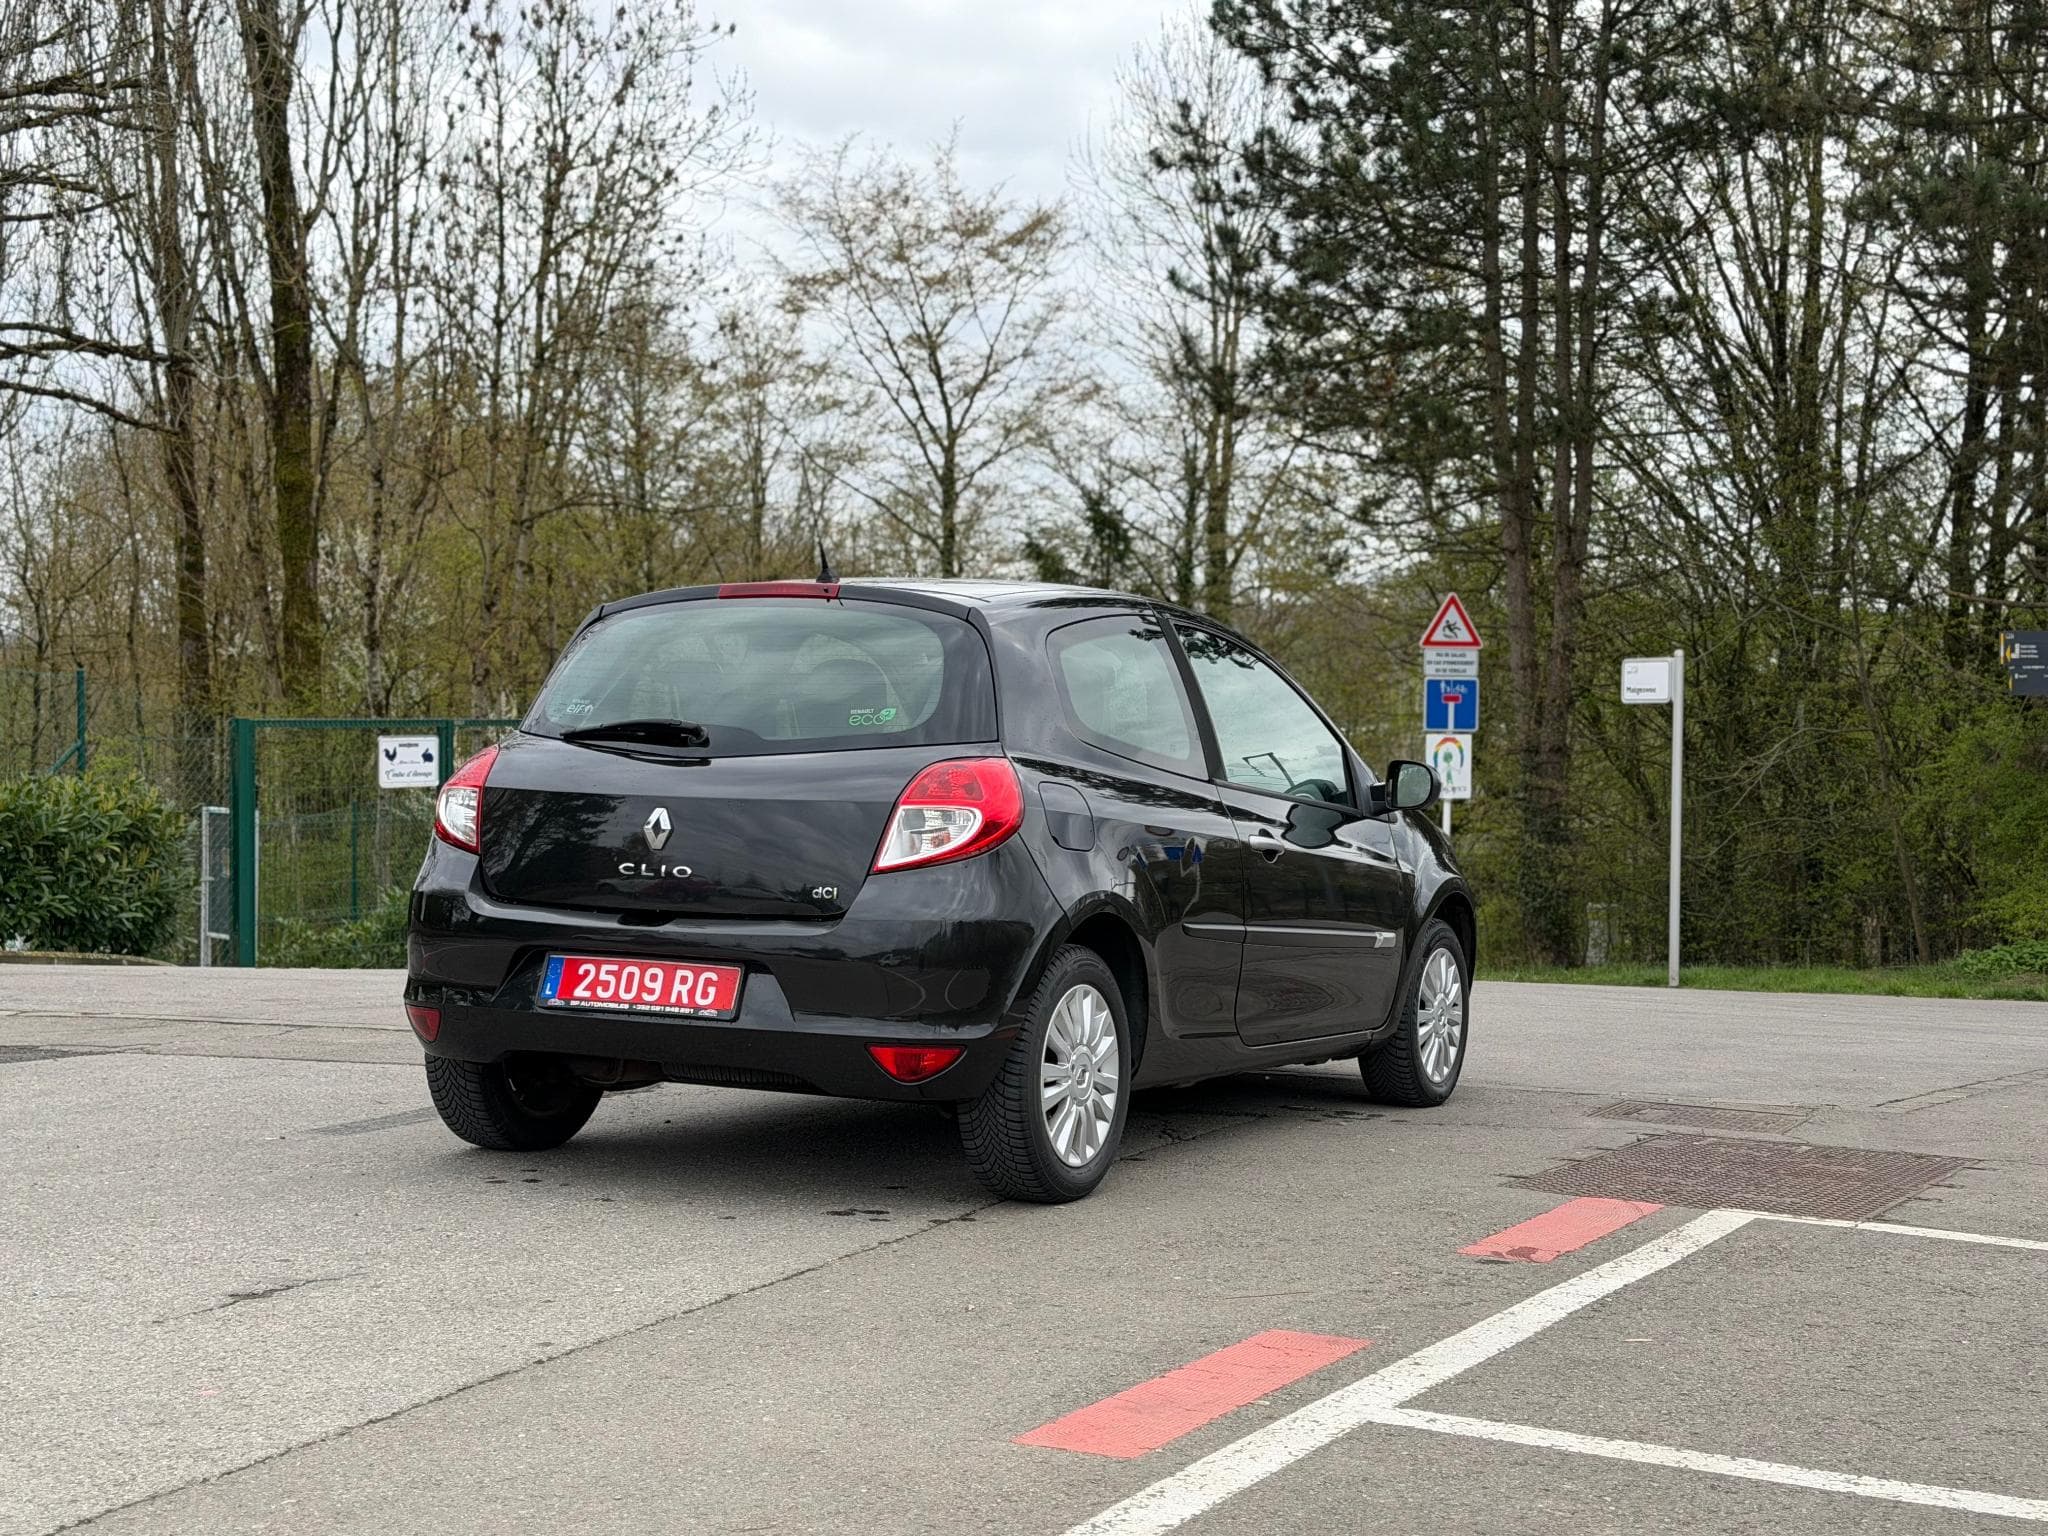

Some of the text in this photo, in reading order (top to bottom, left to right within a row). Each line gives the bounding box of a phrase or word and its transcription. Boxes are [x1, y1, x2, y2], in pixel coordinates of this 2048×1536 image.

[618, 862, 693, 878] CLIO
[545, 983, 552, 995] L
[573, 963, 719, 1006] 2509 RG
